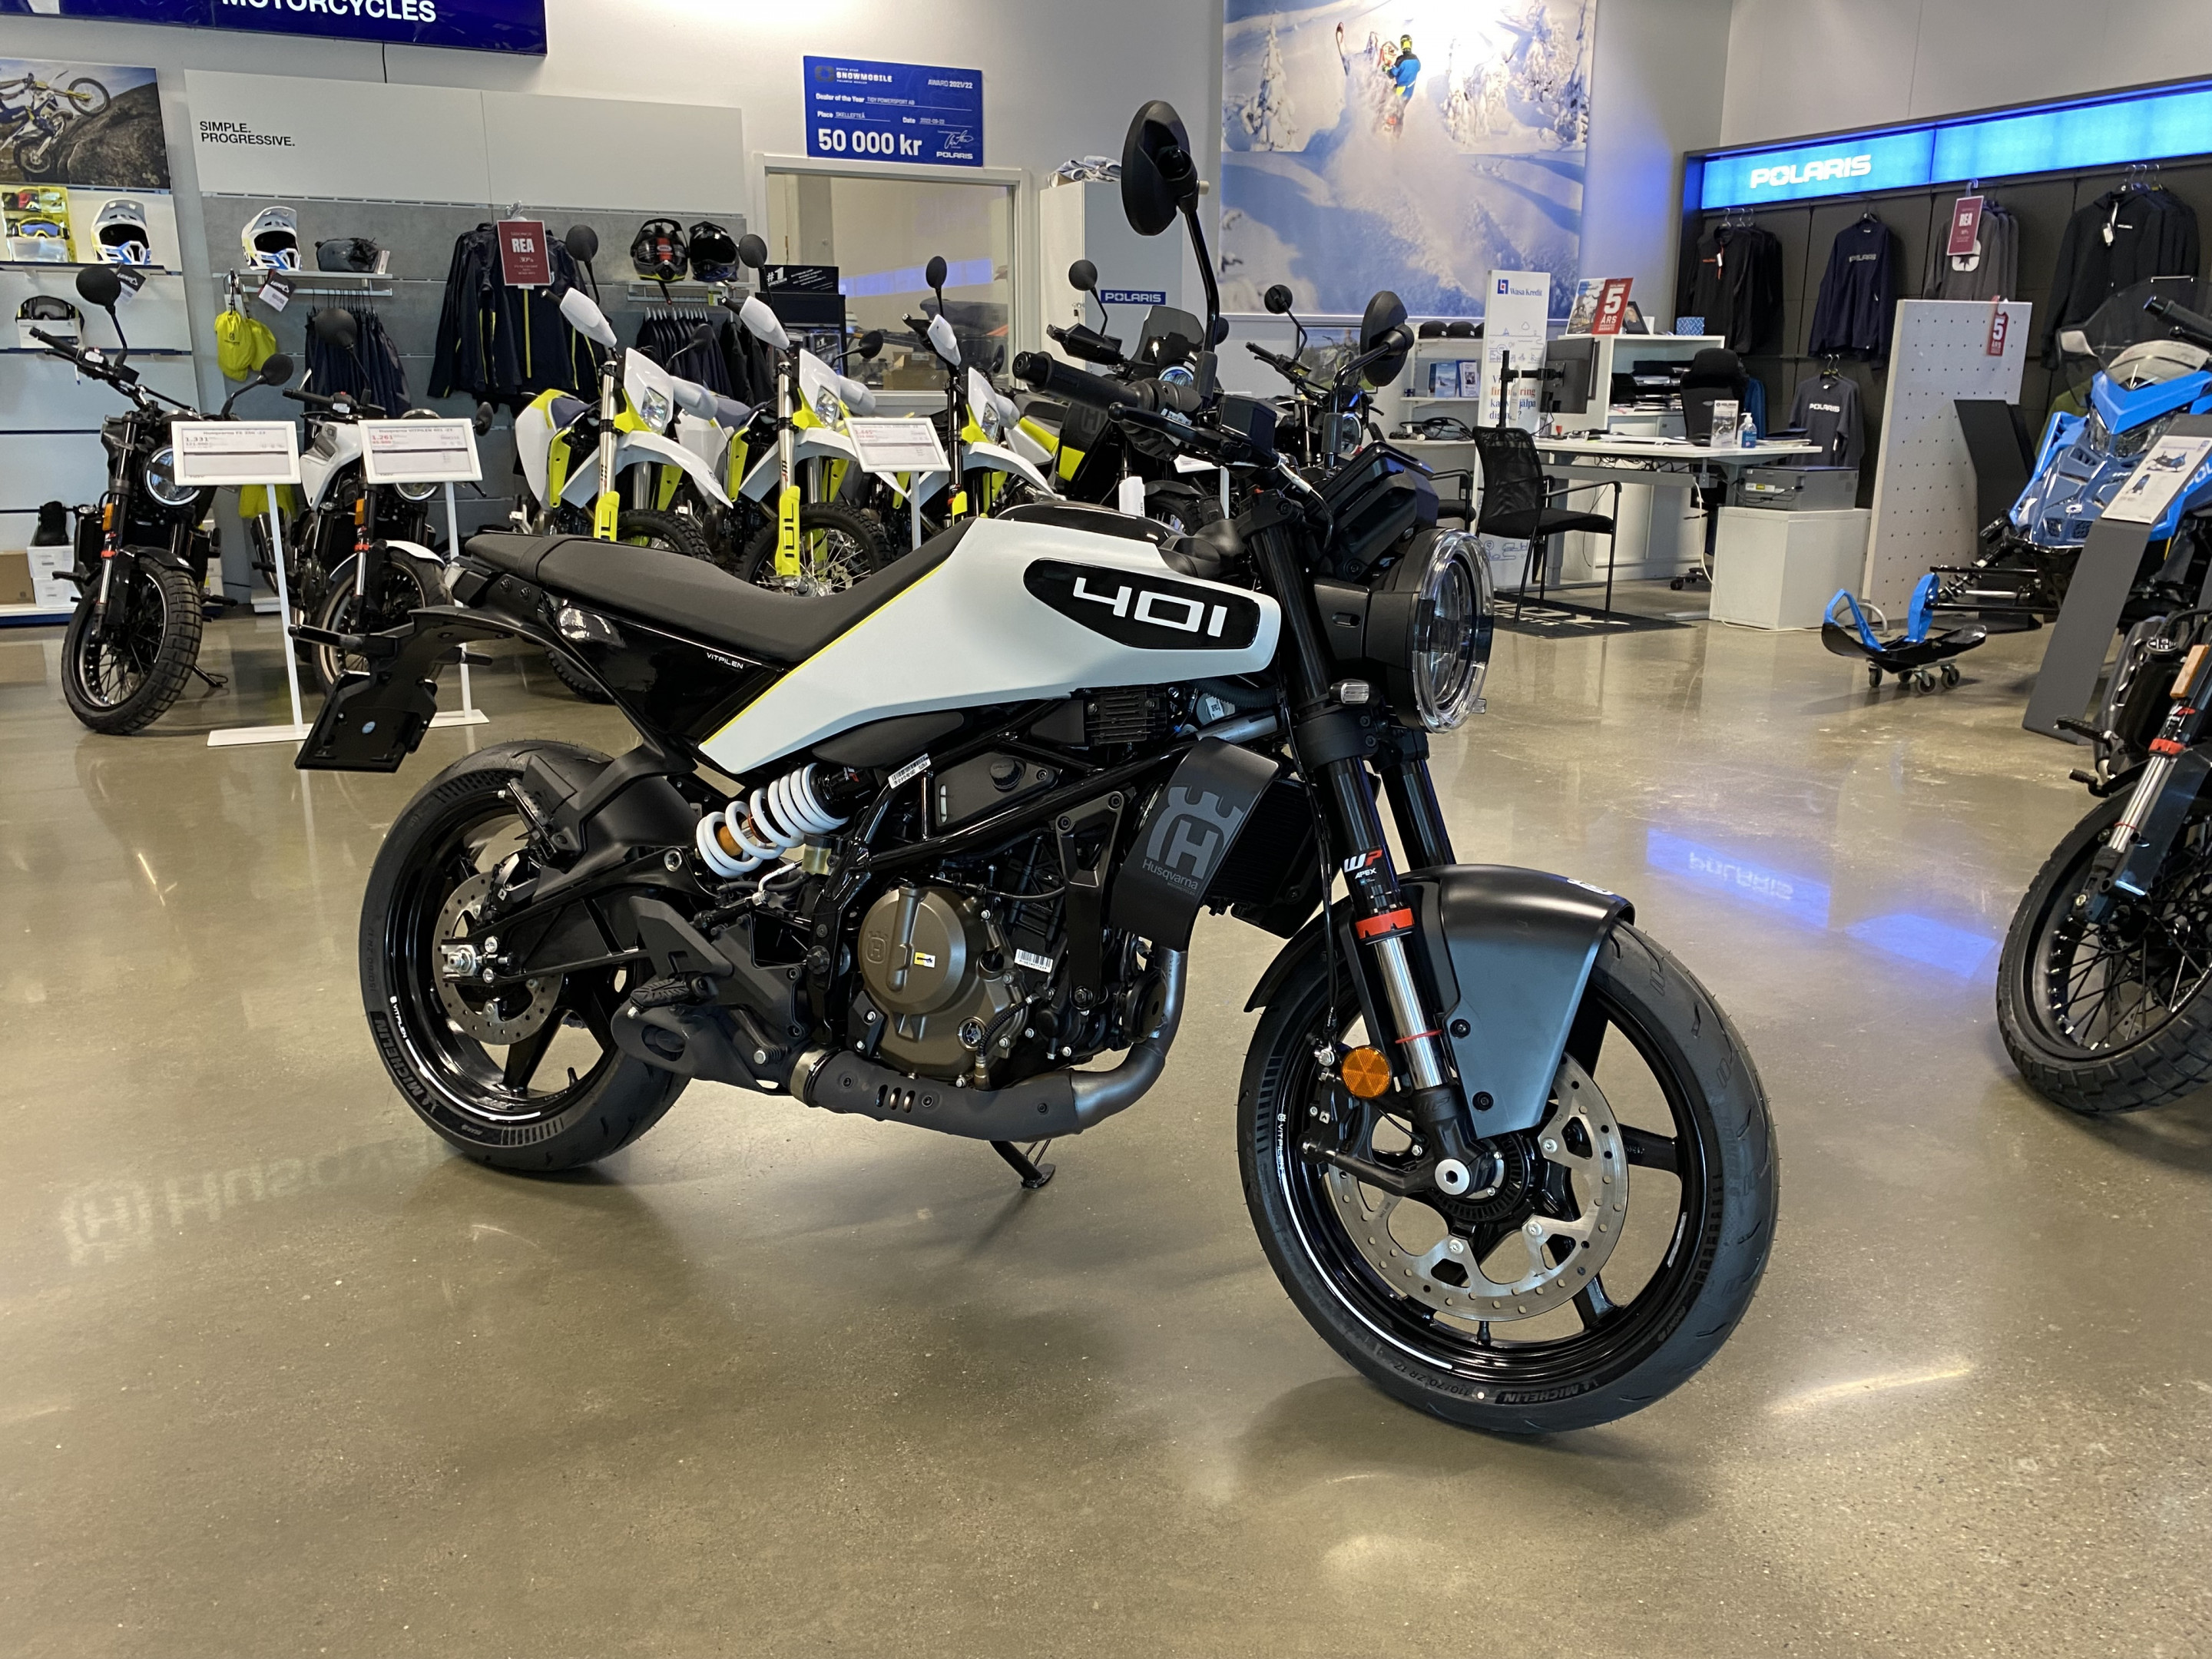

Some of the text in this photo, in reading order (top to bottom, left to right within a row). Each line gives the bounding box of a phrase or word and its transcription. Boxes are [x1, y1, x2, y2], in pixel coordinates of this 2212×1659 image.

[222, 0, 436, 22] ORCYCLES
[836, 71, 892, 82] SNOWMOBILE
[949, 81, 973, 89] 2021/22
[816, 93, 834, 101] Dealer
[200, 121, 252, 133] SIMPLE.
[200, 132, 296, 147] PROGRESSIVE.
[818, 128, 847, 152] 50
[852, 131, 894, 154] 000
[900, 134, 922, 156] kr
[936, 151, 974, 160] POLARIS
[1749, 154, 1872, 189] POLARIS
[511, 238, 535, 253] REA
[1104, 292, 1162, 303] POLARIS
[1525, 288, 1542, 296] Kredit
[1604, 287, 1624, 314] 5
[1601, 313, 1618, 324] ÅRS
[1993, 318, 2005, 340] 5
[1809, 403, 1840, 413] POLARIS
[1073, 577, 1227, 637] 401
[707, 652, 743, 669] VITPILEN
[1344, 849, 1382, 873] WP
[1142, 859, 1198, 890] Husqvarna
[1355, 867, 1377, 879] APEX
[392, 1004, 407, 1038] VITPILEN
[375, 1019, 423, 1096] MICHELIN
[1393, 1362, 1470, 1396] 110/70 ZR 17
[1503, 1386, 1580, 1404] MICHELIN
